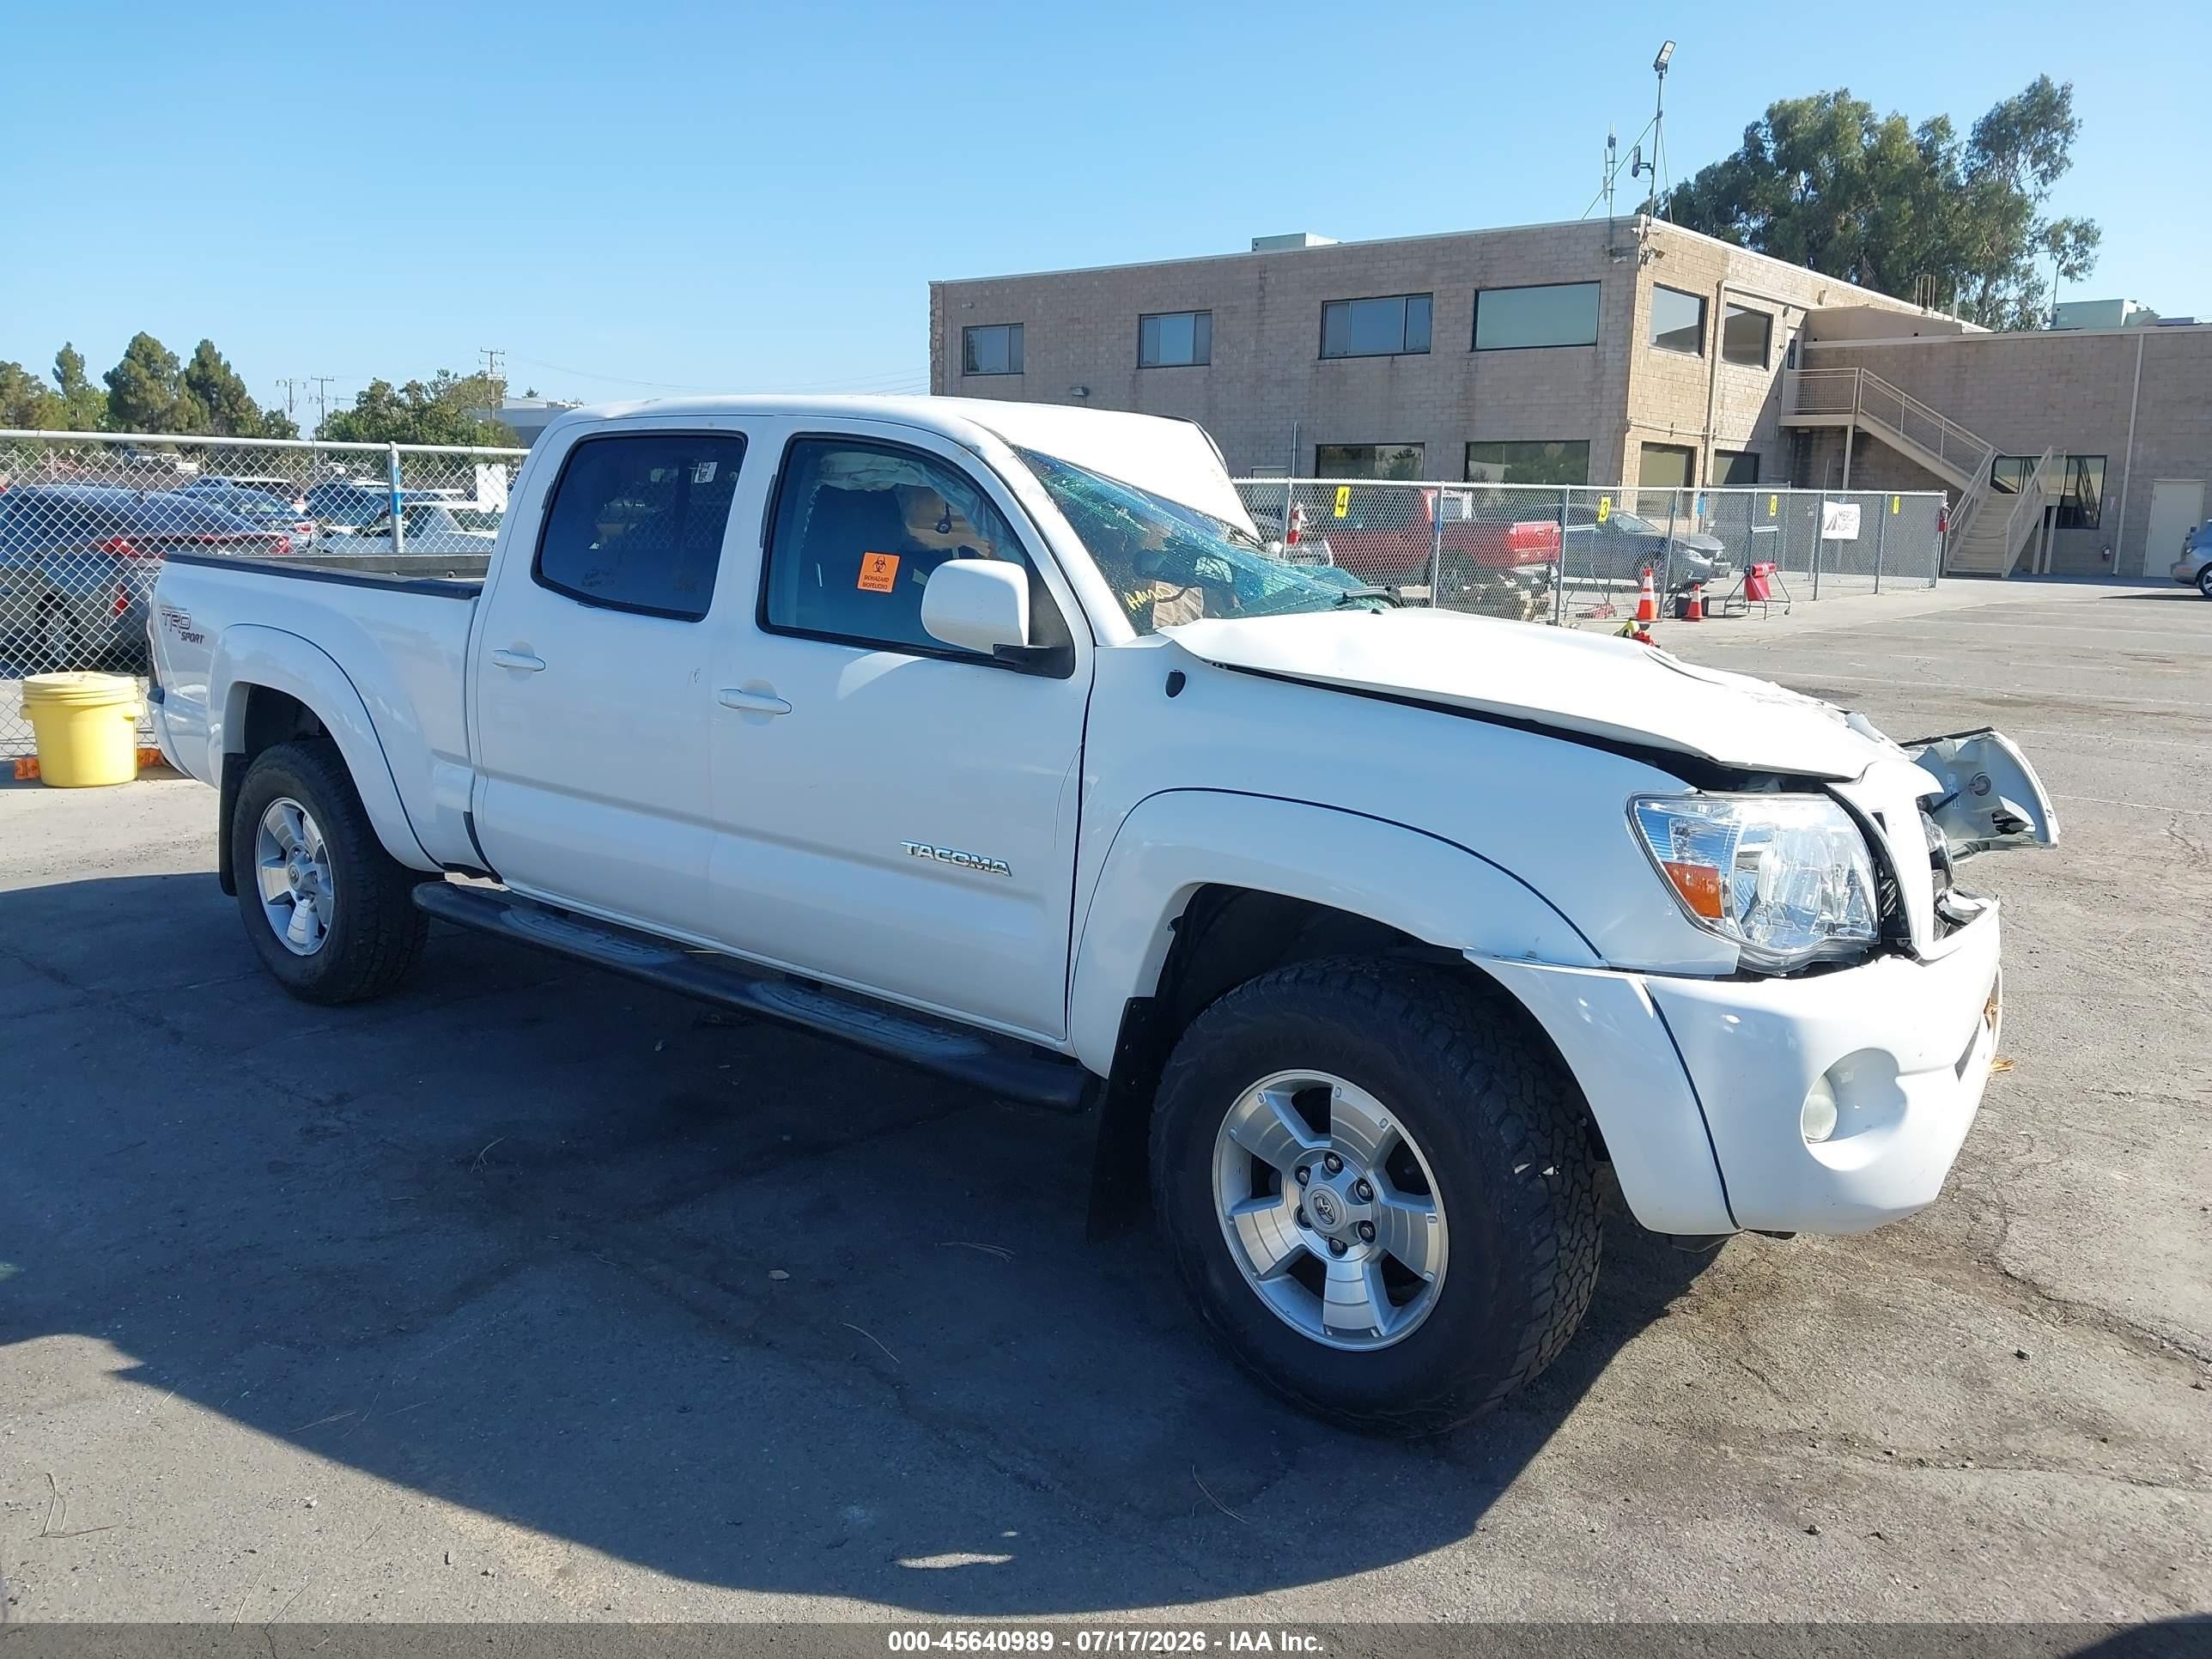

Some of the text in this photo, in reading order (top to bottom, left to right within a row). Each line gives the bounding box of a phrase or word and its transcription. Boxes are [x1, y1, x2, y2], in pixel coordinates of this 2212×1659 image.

[1338, 490, 1346, 513] 4
[1601, 501, 1607, 518] 3
[180, 631, 205, 645] SPORT
[900, 840, 1012, 878] TACOMA
